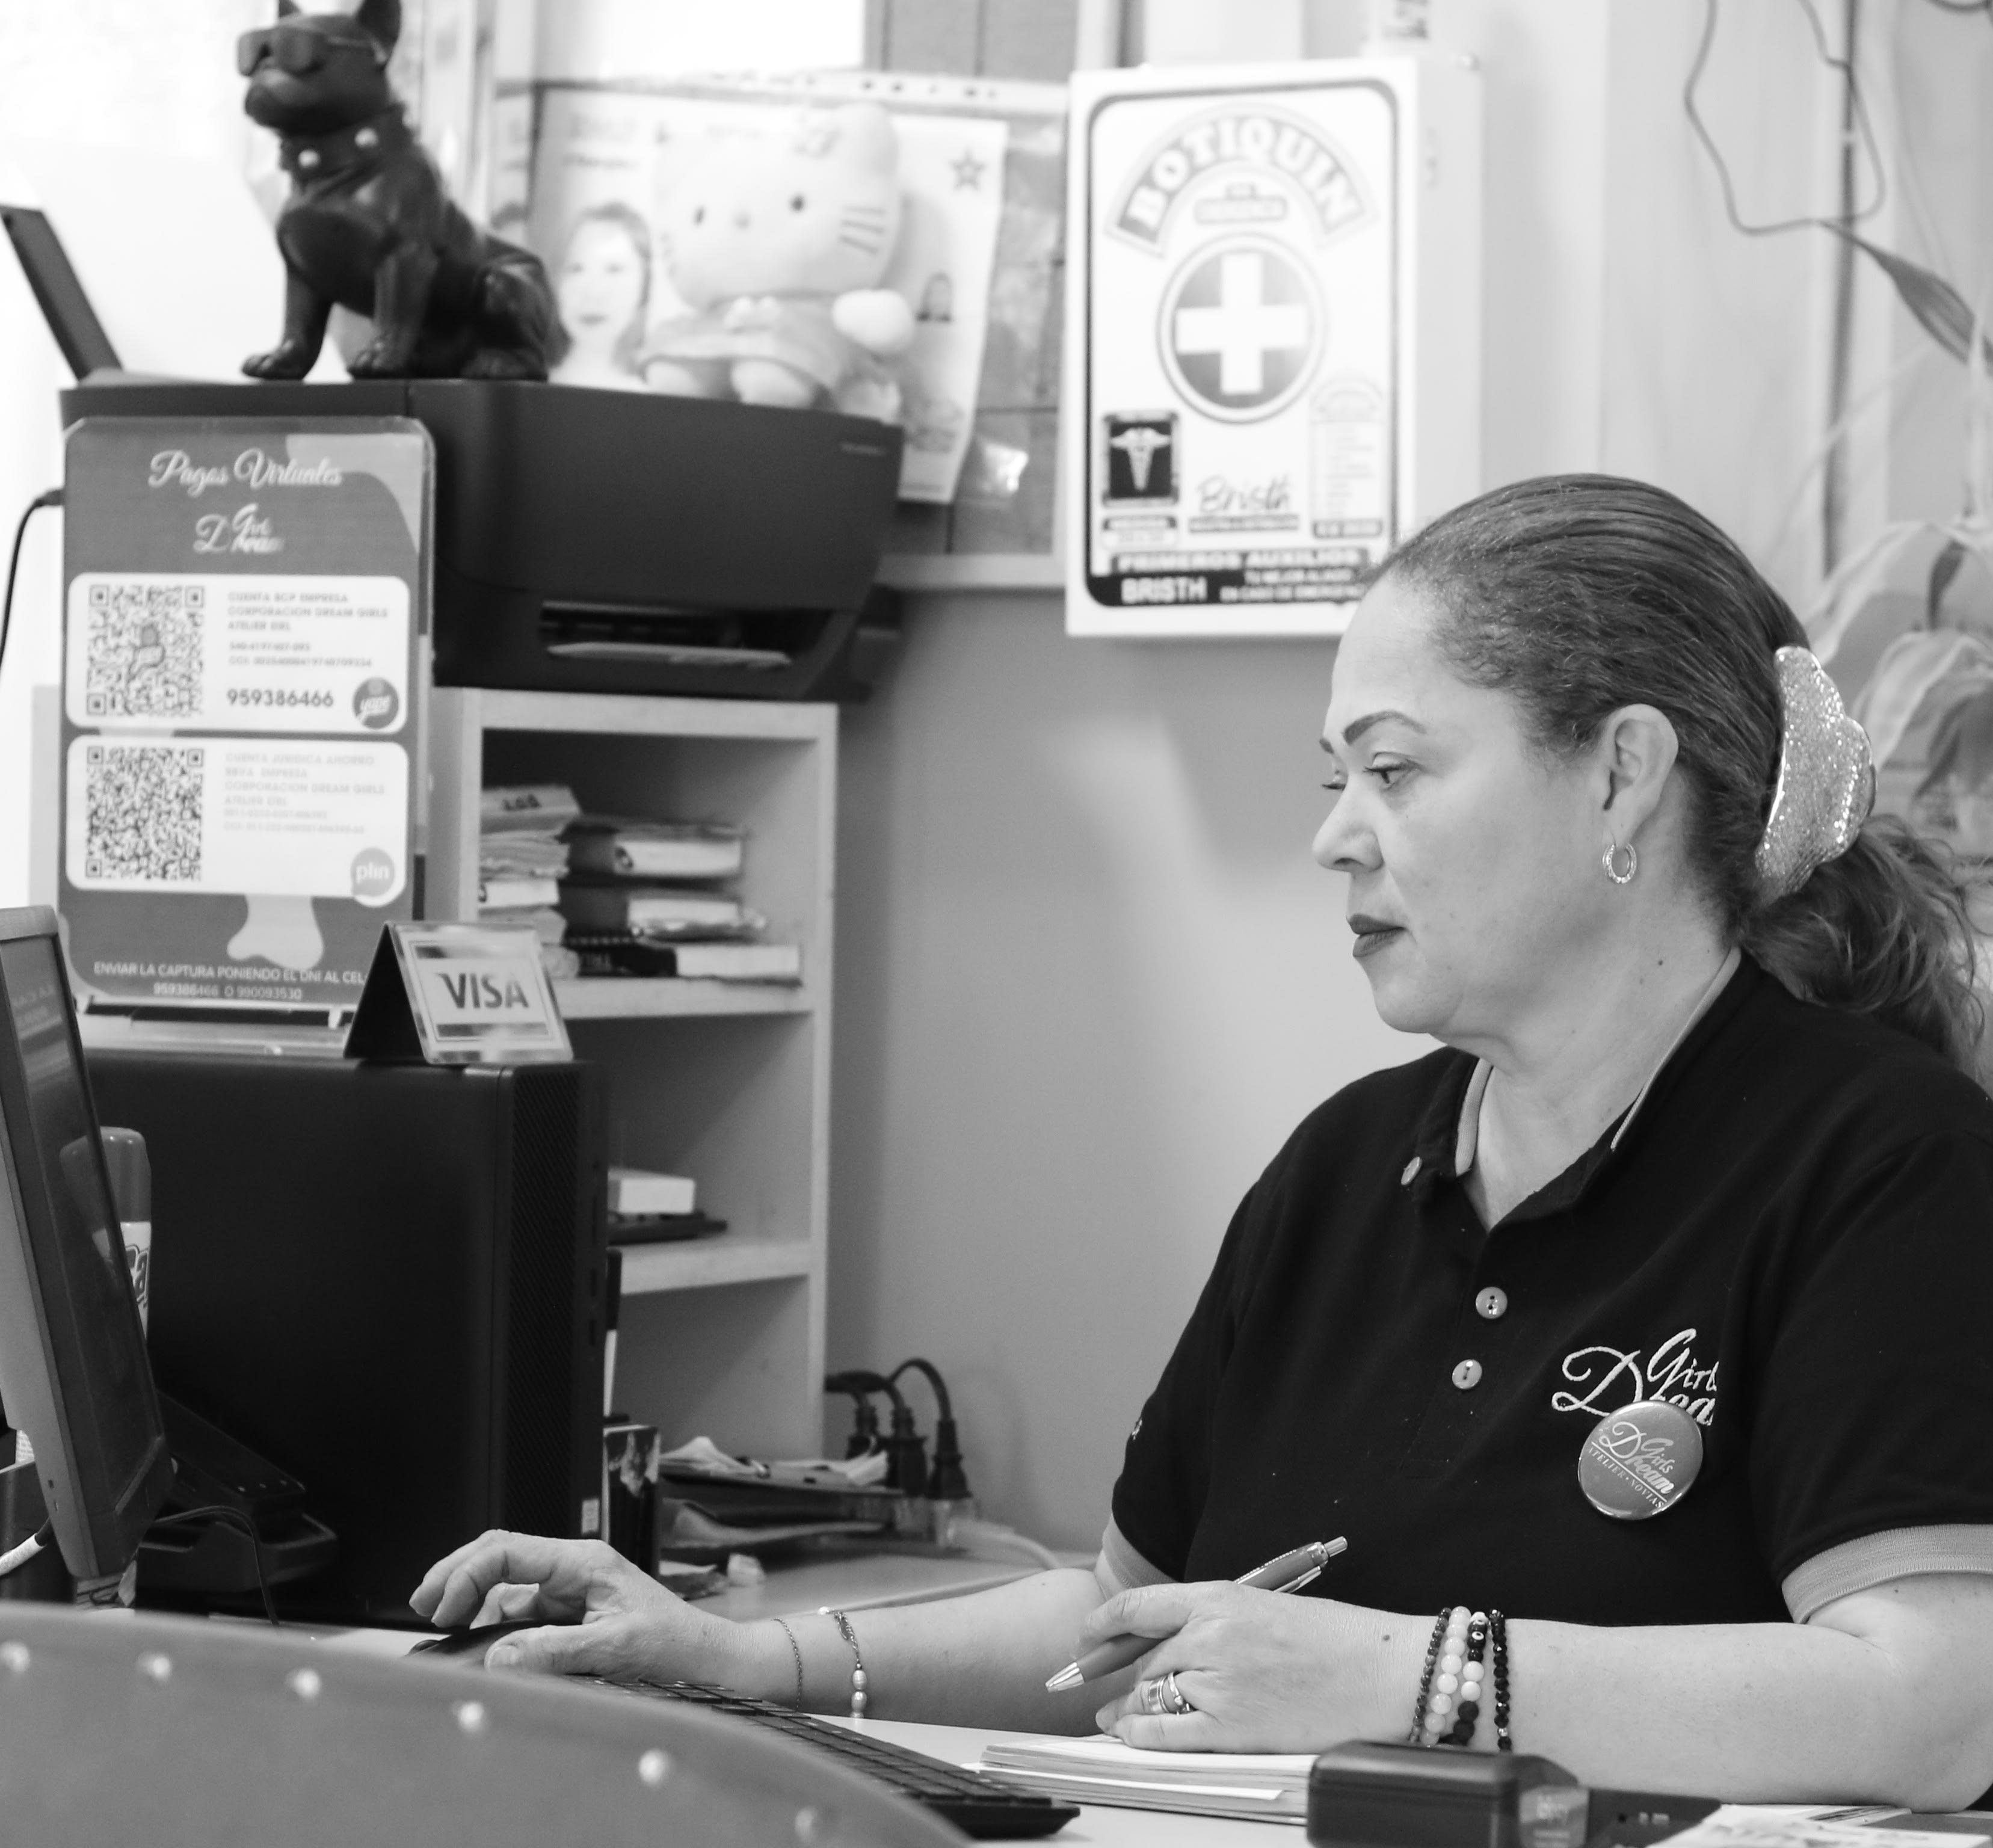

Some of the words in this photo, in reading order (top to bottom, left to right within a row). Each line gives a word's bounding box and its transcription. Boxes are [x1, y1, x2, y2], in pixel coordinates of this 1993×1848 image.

[1126, 117, 1358, 230] BOTIQUIN
[149, 449, 229, 497] Pagos
[233, 448, 343, 490] Virtuales
[1121, 576, 1207, 603] BRISTH
[227, 688, 334, 707] 959386466
[356, 861, 390, 884] plin
[93, 962, 138, 975] ENVIAR
[140, 964, 155, 976] LA
[158, 964, 214, 979] CAPTURA
[217, 966, 280, 981] PONIENDO
[300, 970, 321, 983] DNI
[324, 971, 340, 984] AL
[436, 973, 529, 1009] VISA
